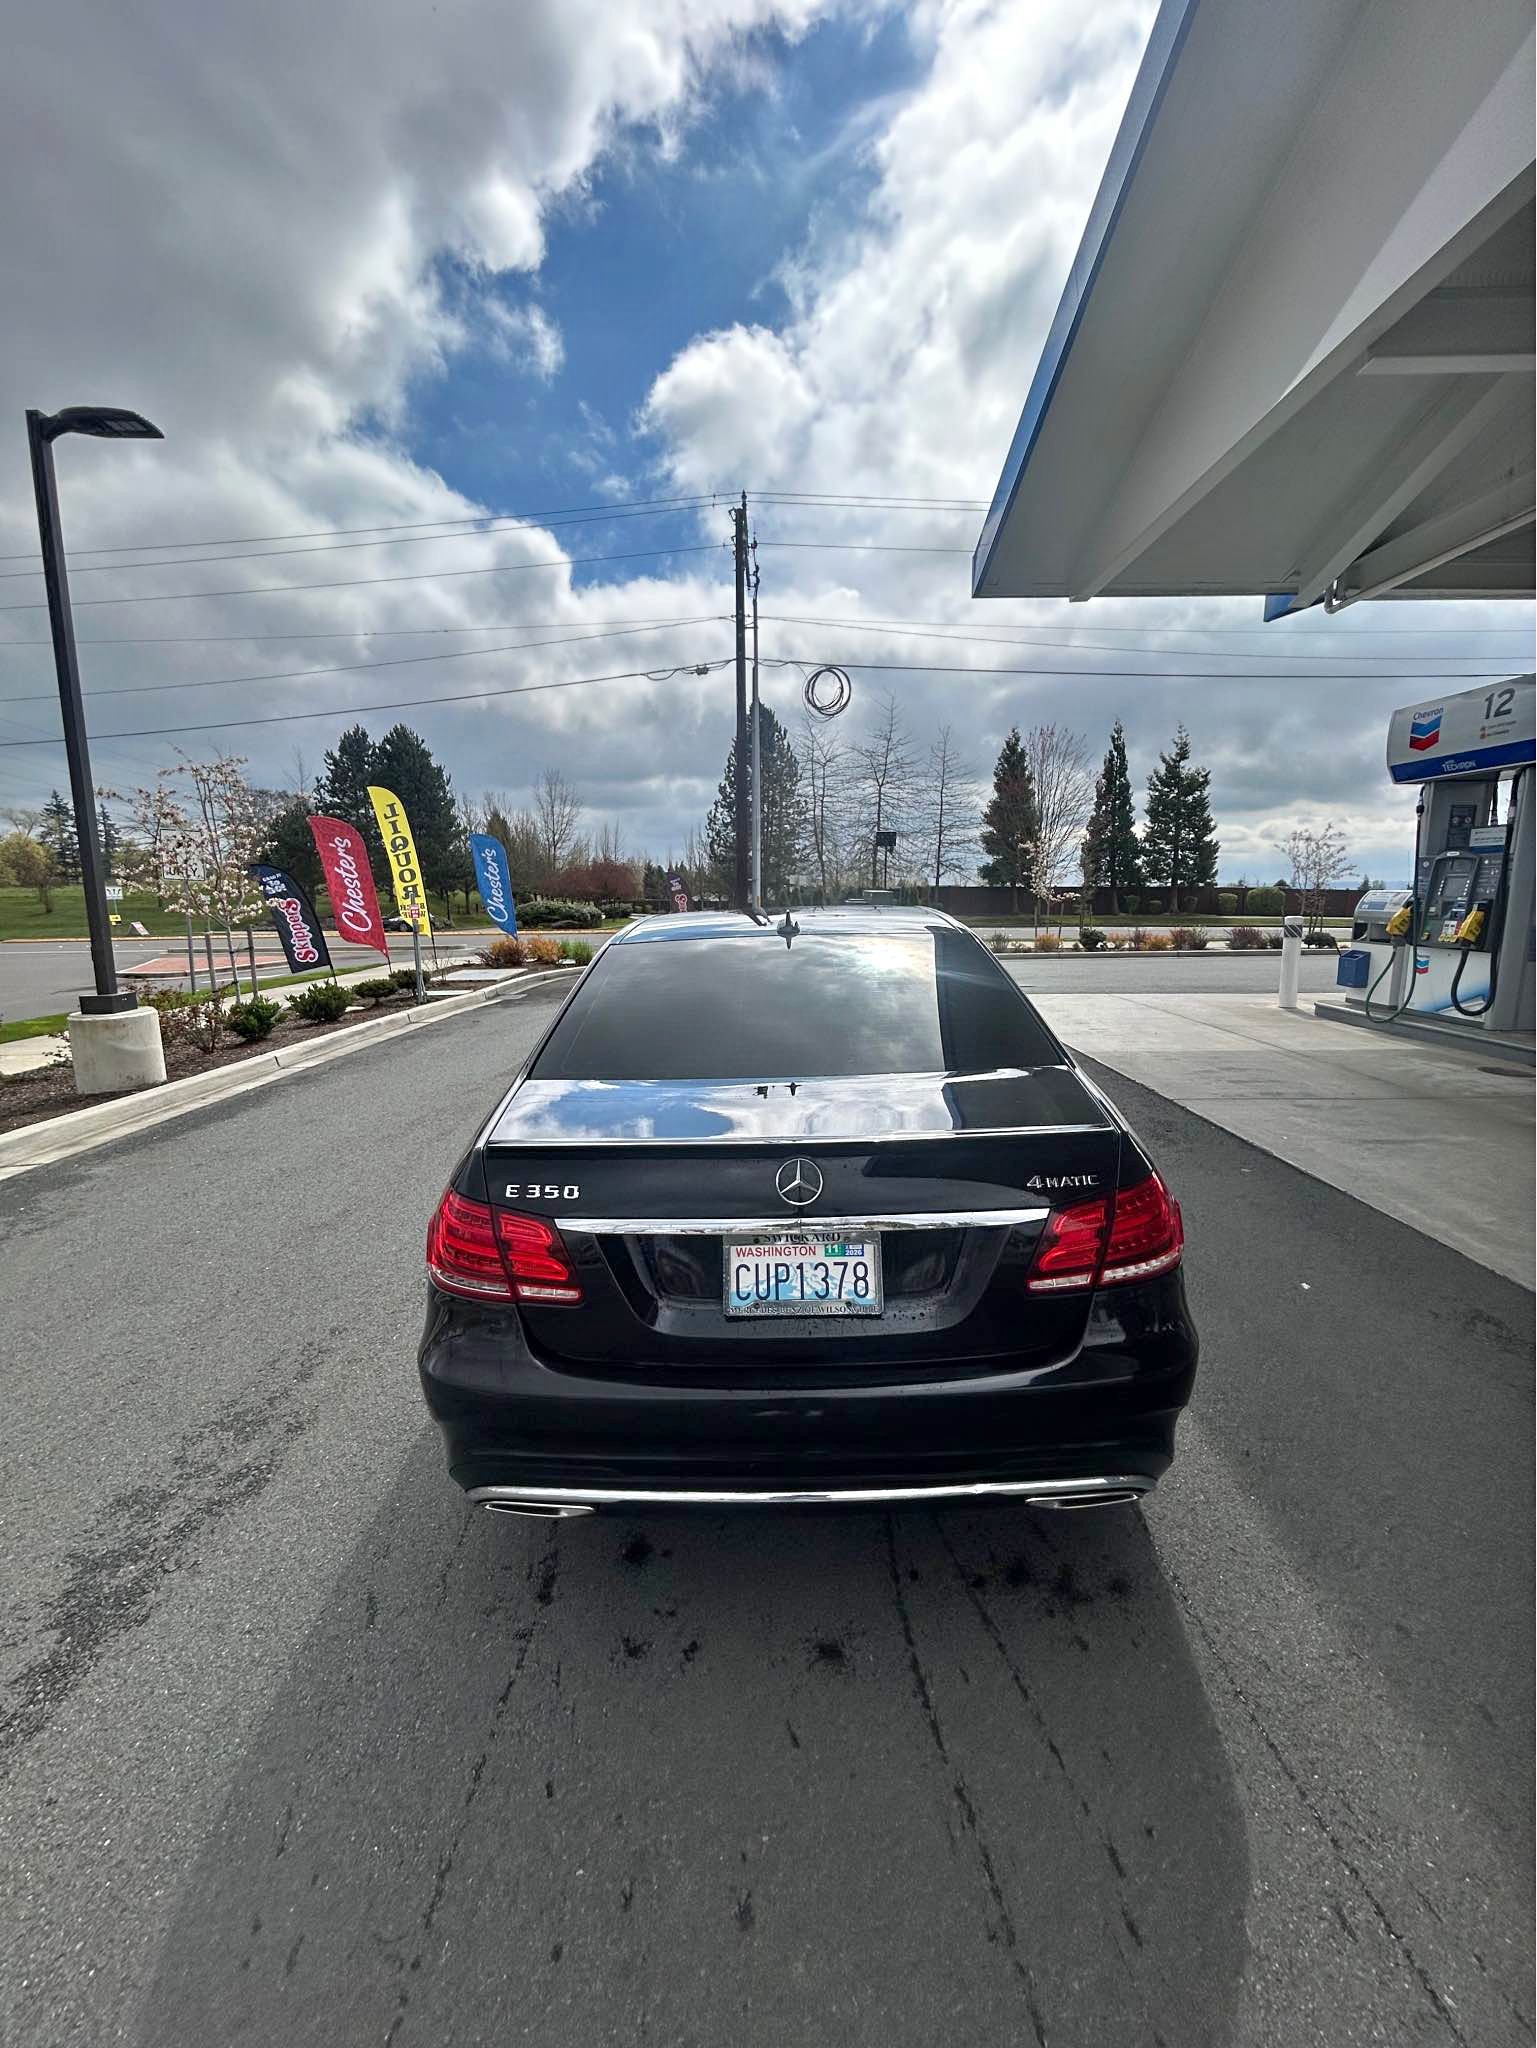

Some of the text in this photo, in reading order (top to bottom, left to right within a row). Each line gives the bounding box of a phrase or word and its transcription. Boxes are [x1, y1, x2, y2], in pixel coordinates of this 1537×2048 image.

[1484, 688, 1516, 720] 12
[1413, 707, 1444, 720] Chevron
[329, 836, 372, 932] Chester's
[481, 848, 509, 922] Chester's
[1026, 1175, 1100, 1188] 4MATIC
[505, 1184, 580, 1199] E 350
[765, 1233, 841, 1243] SWICKARD
[736, 1245, 816, 1257] WASHINGTON
[735, 1261, 869, 1301] CUP1378
